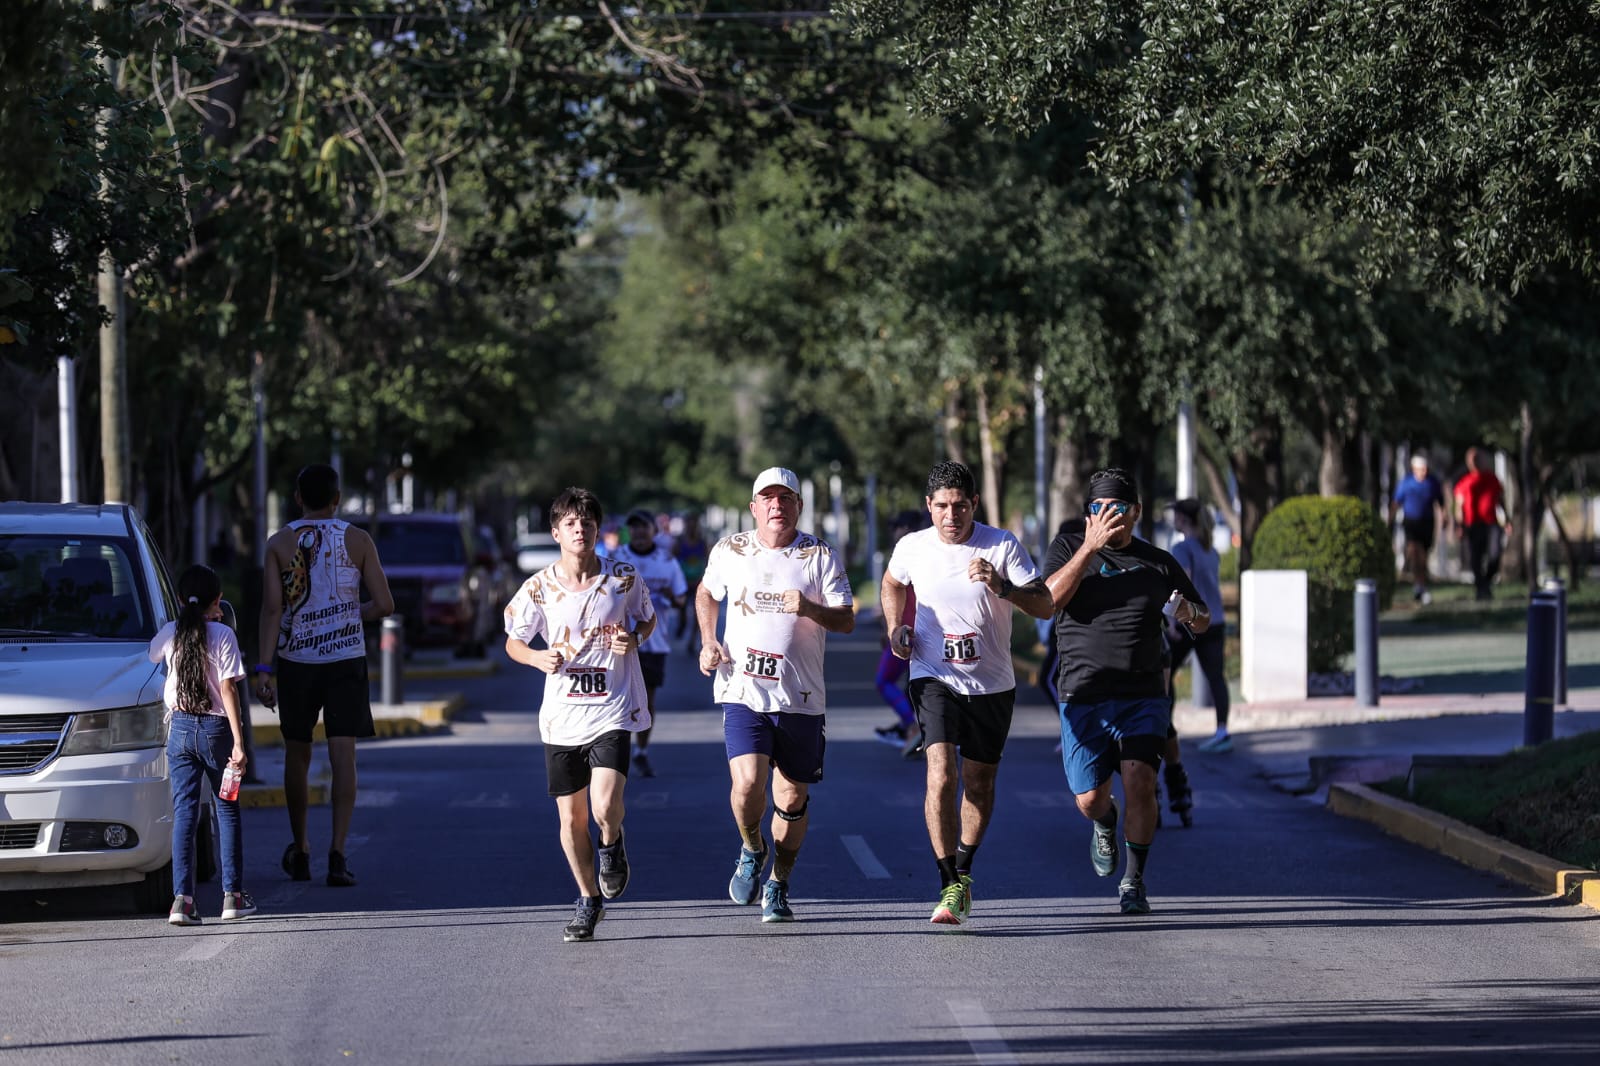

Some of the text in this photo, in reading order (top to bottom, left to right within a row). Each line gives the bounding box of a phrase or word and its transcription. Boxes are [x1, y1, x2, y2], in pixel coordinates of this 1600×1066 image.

[295, 629, 314, 640] CLUB
[944, 638, 976, 659] 513
[745, 653, 778, 677] 313
[569, 672, 607, 694] 208
